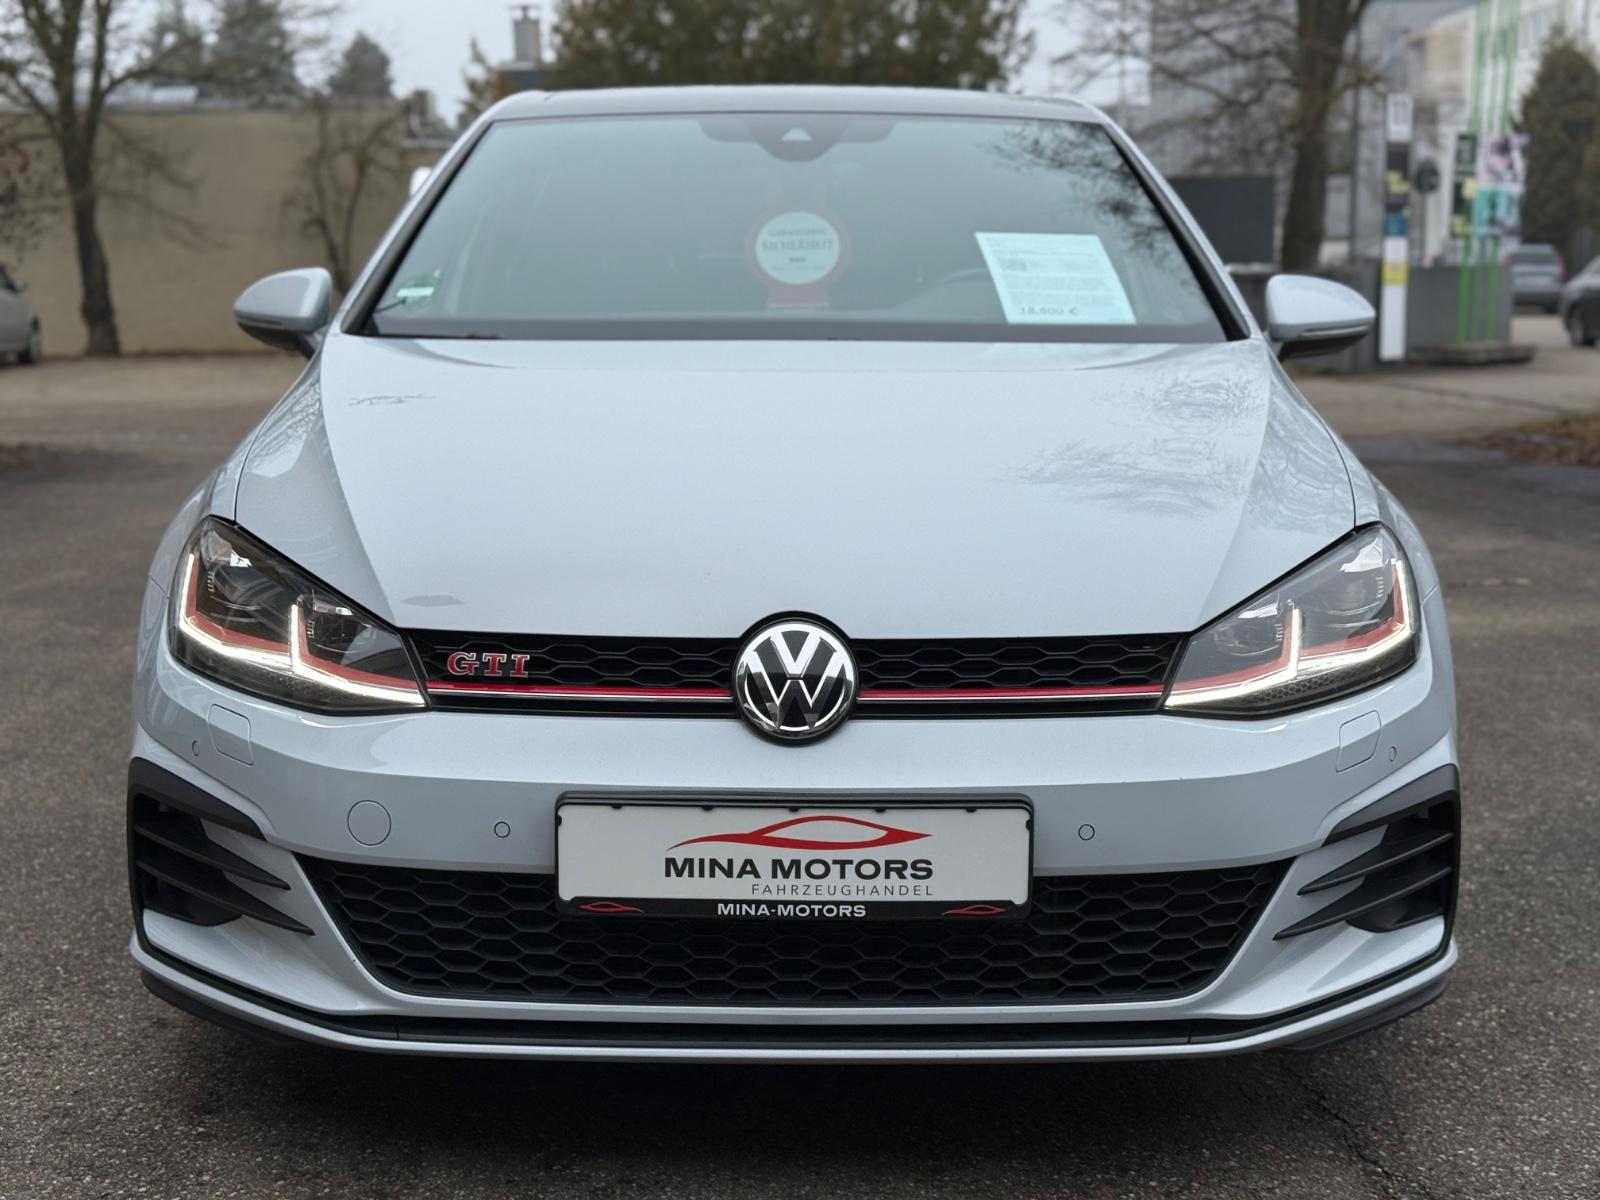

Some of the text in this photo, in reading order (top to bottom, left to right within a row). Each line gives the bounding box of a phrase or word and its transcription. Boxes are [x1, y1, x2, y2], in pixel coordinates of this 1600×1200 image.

[446, 651, 530, 678] GTI
[664, 857, 934, 880] MINA MOTORS
[751, 883, 934, 897] FAHRZEUGHANDEL
[717, 903, 867, 918] MINA-MOTORS
